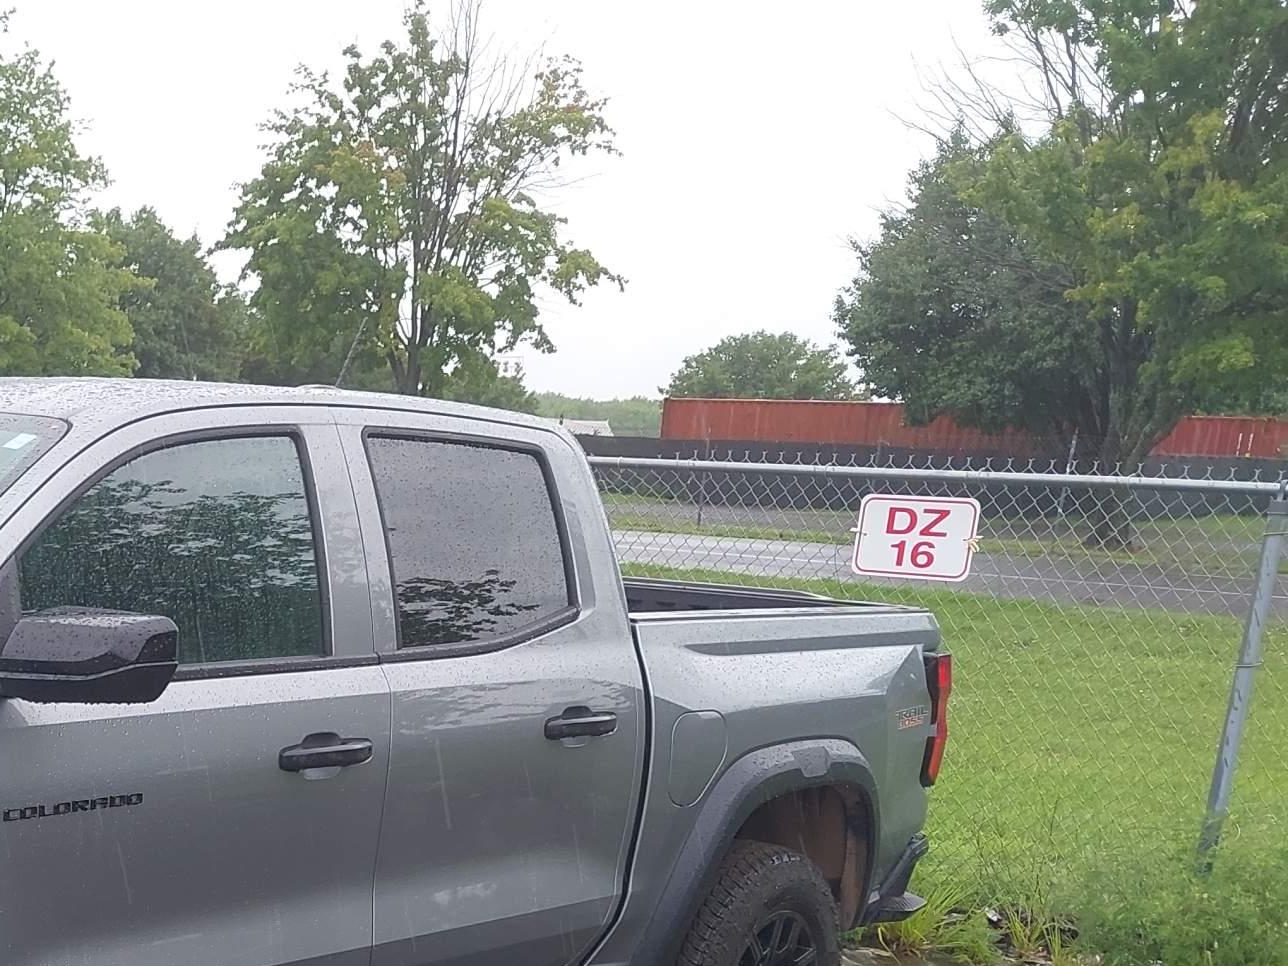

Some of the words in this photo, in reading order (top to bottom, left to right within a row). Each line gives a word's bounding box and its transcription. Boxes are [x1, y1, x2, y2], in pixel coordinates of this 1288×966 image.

[885, 506, 951, 538] DZ
[890, 540, 936, 569] 16
[2, 792, 144, 822] COLORADO
